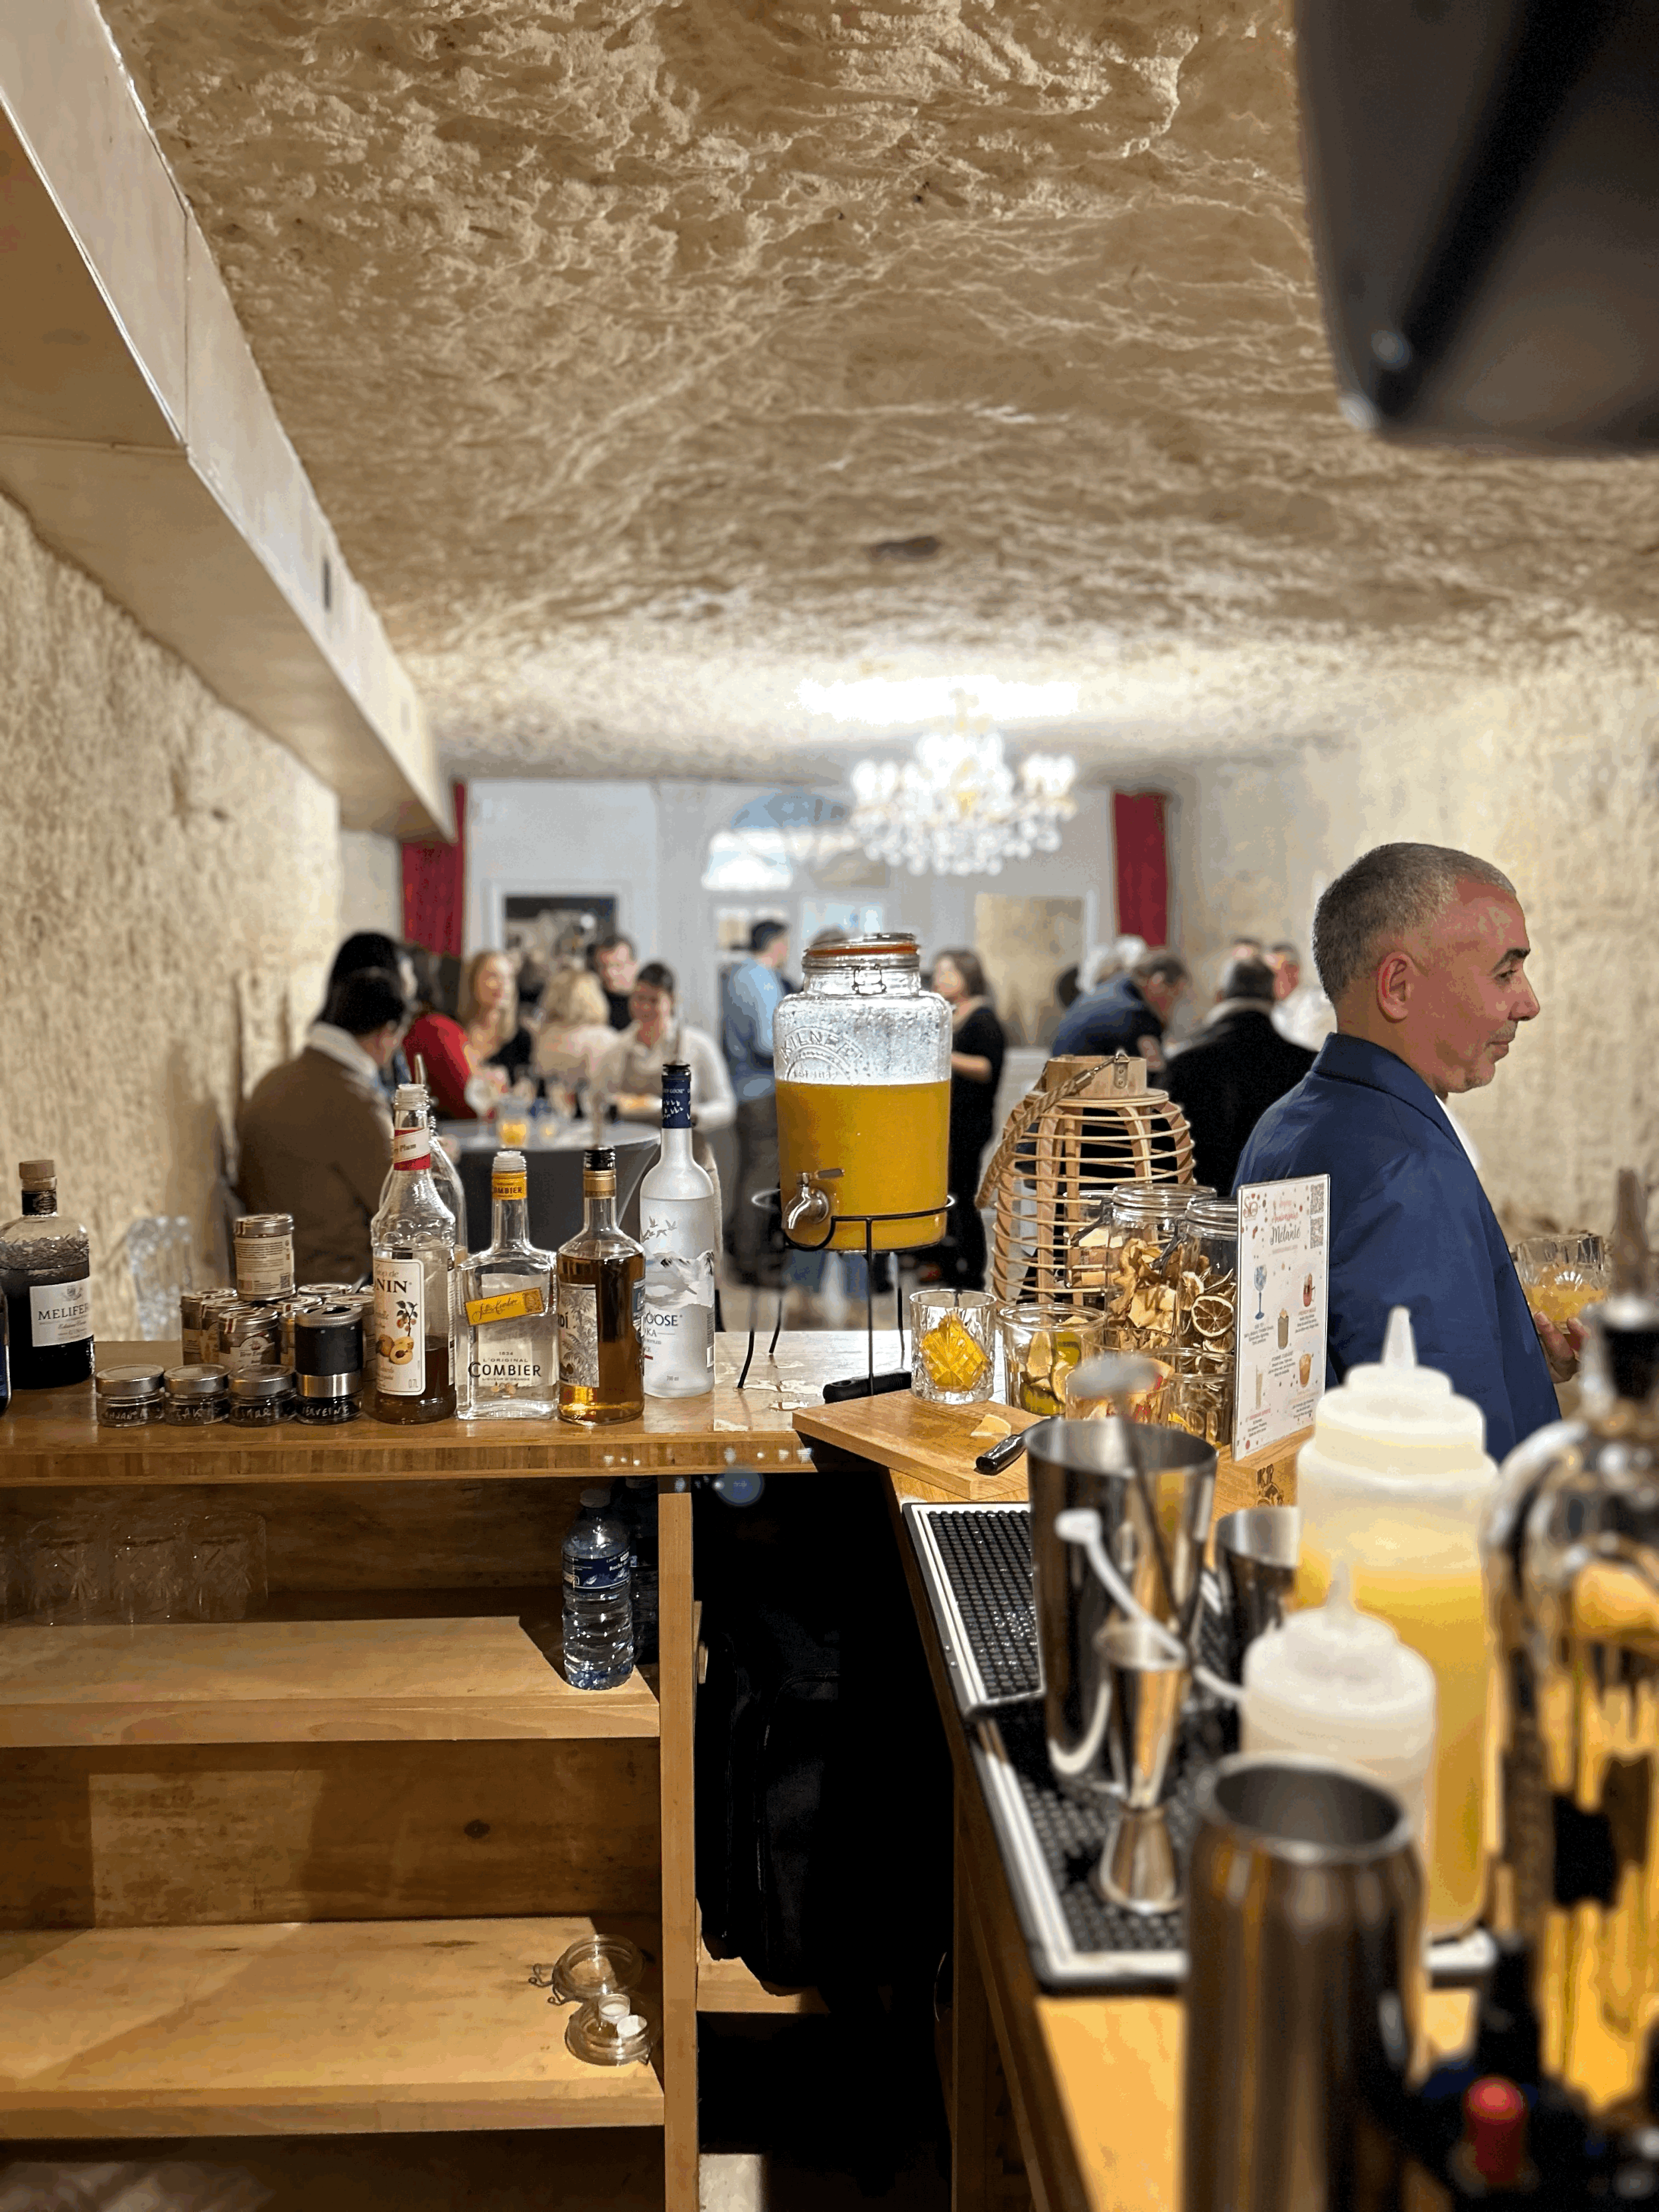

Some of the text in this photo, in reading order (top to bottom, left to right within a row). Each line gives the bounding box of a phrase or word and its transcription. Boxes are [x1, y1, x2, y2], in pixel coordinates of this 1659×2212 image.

[375, 1279, 407, 1293] NIN
[644, 1313, 679, 1326] OOSE
[468, 1361, 542, 1377] COMBIER
